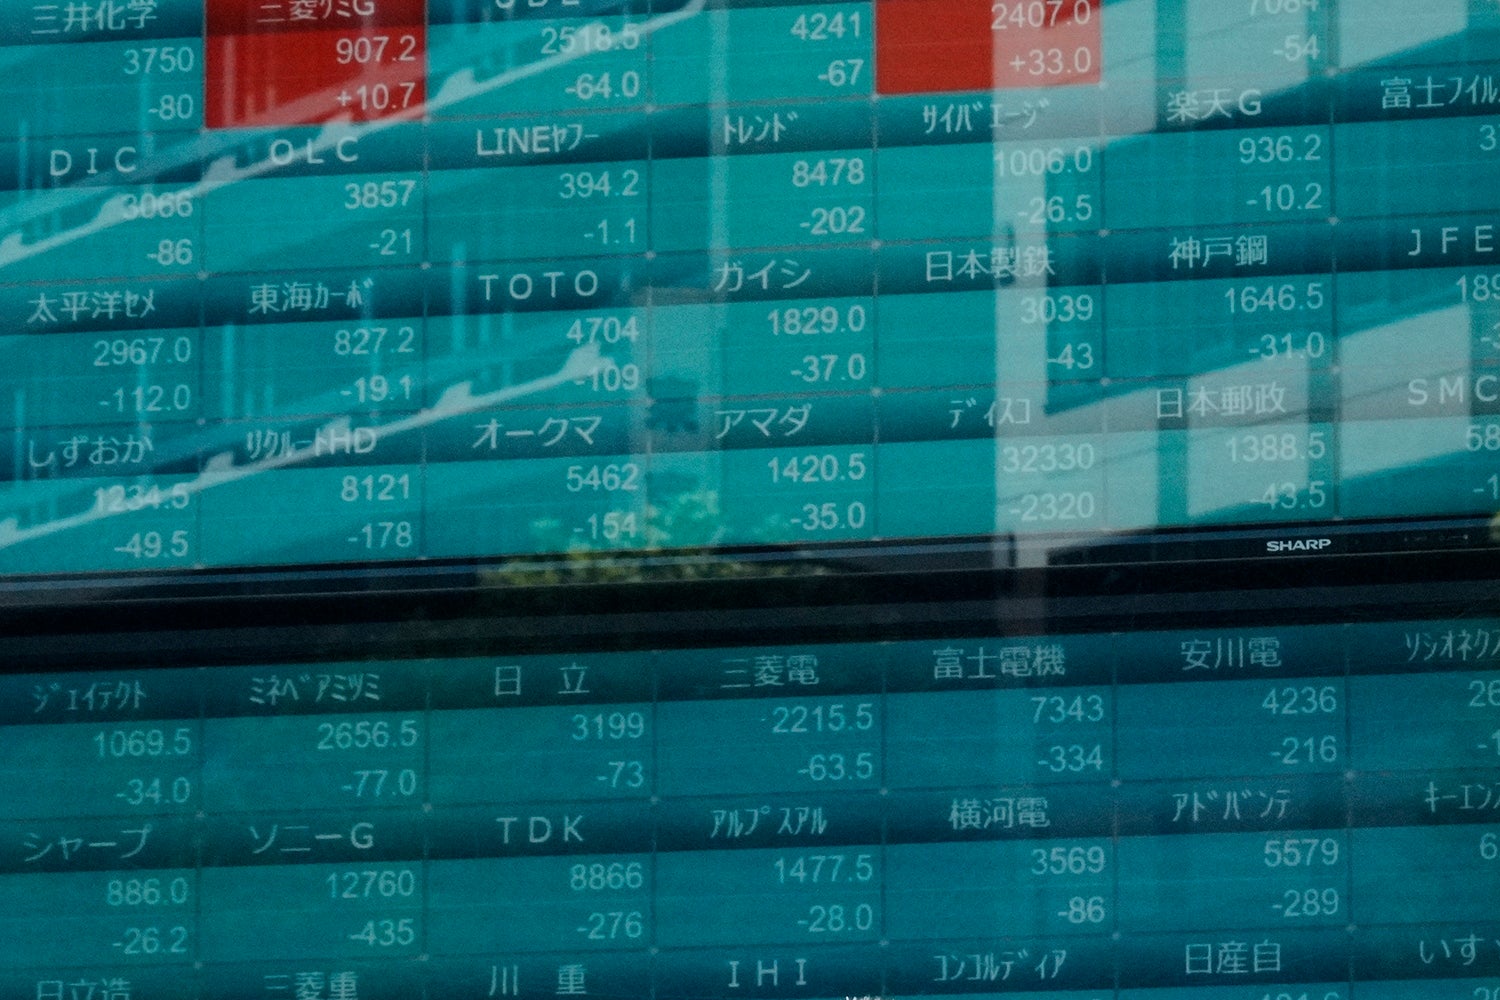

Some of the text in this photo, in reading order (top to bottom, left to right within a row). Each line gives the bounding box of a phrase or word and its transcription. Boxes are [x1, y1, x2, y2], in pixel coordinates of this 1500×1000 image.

[791, 13, 862, 40] 4241
[123, 47, 193, 74] 3750
[336, 36, 416, 64] 907.2
[1009, 47, 1091, 75] +33.0
[148, 95, 193, 120] -80
[337, 83, 415, 110] +10.7
[1167, 88, 1262, 123] 楽天G
[1239, 134, 1321, 162] 936.2
[559, 171, 639, 199] 394.2
[793, 158, 865, 186] 8478
[345, 181, 415, 208] 3857
[926, 247, 1055, 282] 日本製鉄
[1169, 236, 1268, 268] 神戸鋼
[714, 259, 812, 293] ガイシ
[1021, 295, 1093, 323] 3039
[1225, 284, 1323, 312] 1646.5
[767, 305, 865, 335] 1829.0
[94, 339, 192, 366] 2967.0
[1155, 382, 1286, 418] 日本郵政
[474, 416, 601, 448] オークマ
[714, 405, 810, 438] アマダ
[29, 436, 152, 465] しずおか
[341, 475, 410, 502] 8121
[566, 465, 639, 492] 5462
[347, 522, 412, 548] -178
[1267, 538, 1331, 552] SHARP
[933, 645, 1065, 680] 富士電機
[1180, 636, 1281, 670] 安川電
[721, 655, 819, 687] 三菱電
[1030, 694, 1104, 722] 7343
[1262, 688, 1337, 715] 4236
[571, 713, 644, 741] 3199
[771, 704, 873, 733] 2215.5
[317, 720, 417, 749] 2656.5
[949, 798, 1049, 830] 横河電
[25, 826, 151, 861] シャープ
[250, 823, 375, 853] ソニーG
[1030, 848, 1105, 874] 3569
[1264, 840, 1339, 866] 5579
[570, 863, 642, 889] 8866
[773, 855, 873, 883] 1477.5
[107, 877, 188, 905] 886.0
[326, 870, 414, 898] 12760
[577, 912, 642, 939] -276
[1186, 941, 1281, 974] 日産自
